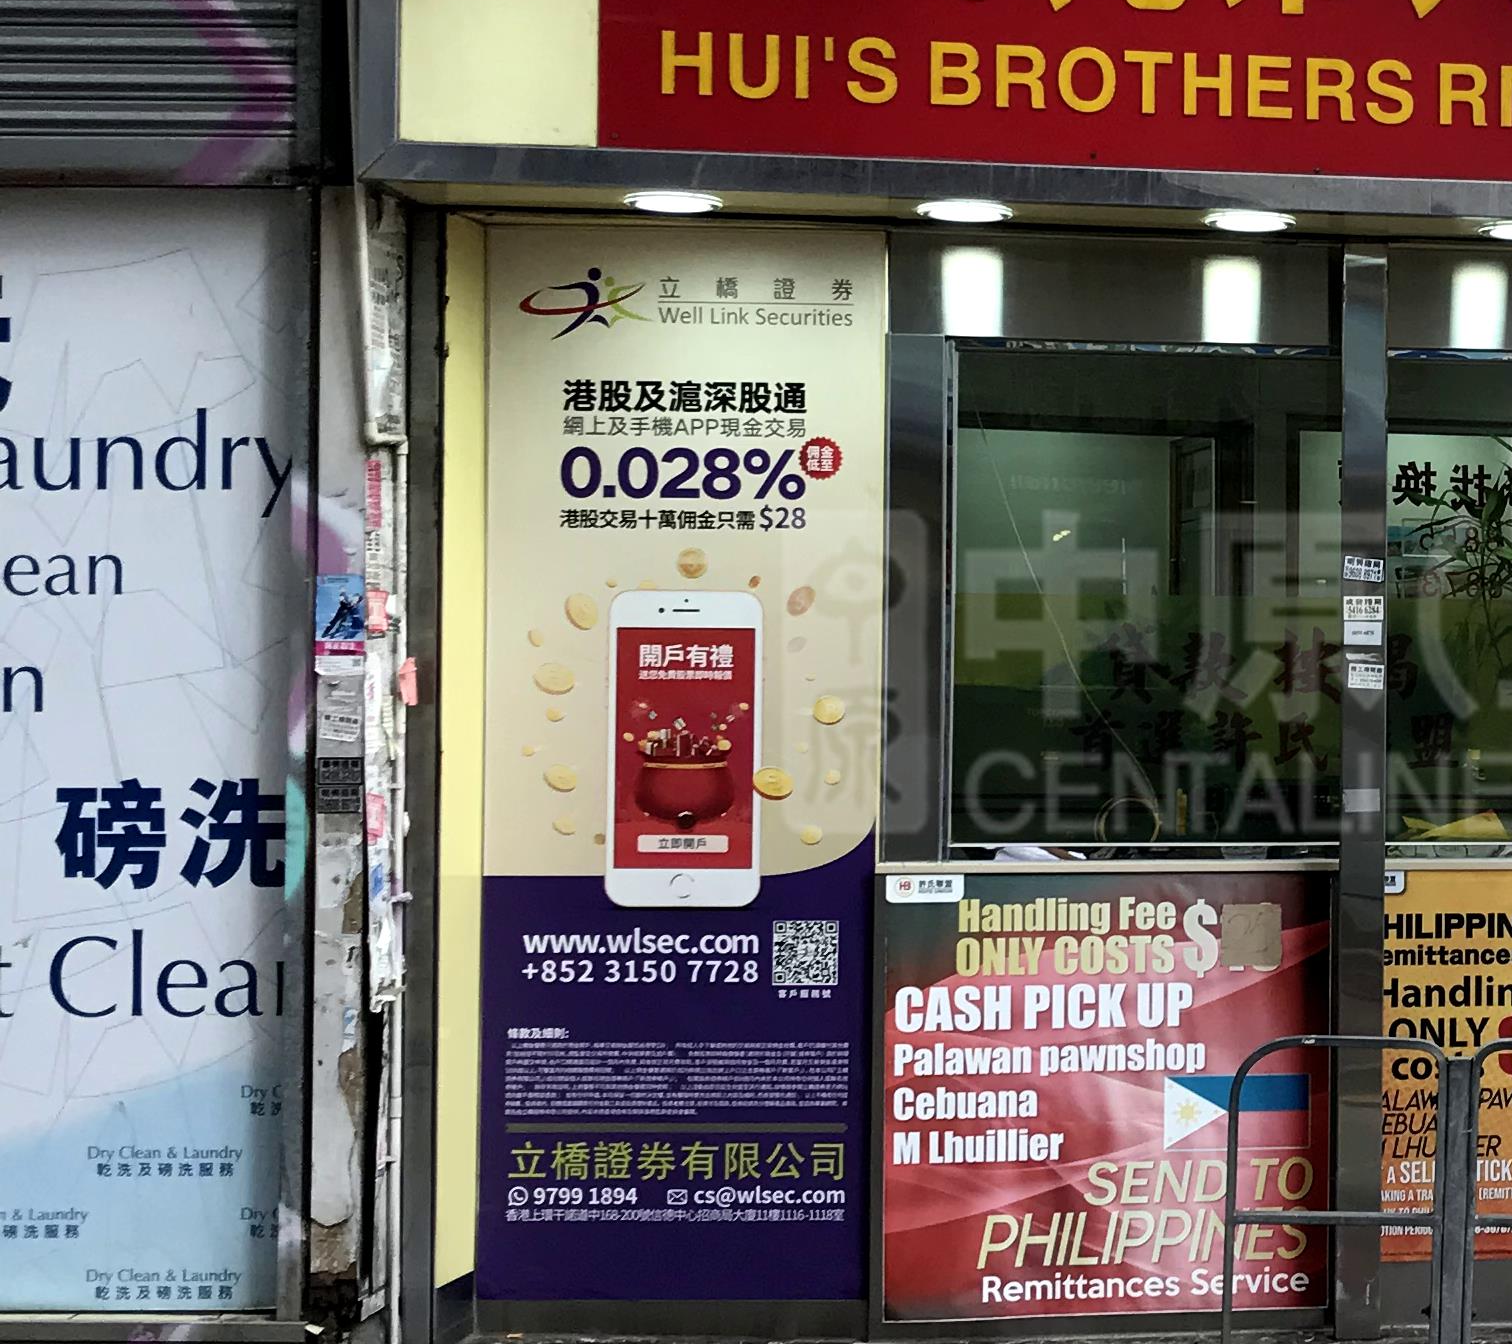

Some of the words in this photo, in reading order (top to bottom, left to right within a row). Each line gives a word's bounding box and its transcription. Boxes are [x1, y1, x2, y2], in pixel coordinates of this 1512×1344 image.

[660, 30, 899, 105] HUI'S
[929, 40, 1414, 126] BROTHERS
[658, 275, 854, 302] 立橋證券
[658, 306, 704, 325] Well
[710, 306, 750, 326] Link
[755, 307, 854, 328] Securities
[562, 379, 808, 414] 港股及滬深股通
[562, 416, 806, 438] 網上及手機APP現金交易
[0, 407, 293, 519] aundry
[560, 446, 807, 501] 0.028%
[559, 509, 756, 530] 港股交易十萬佣金只需
[758, 504, 807, 532] $28
[2, 553, 124, 597] ean
[638, 643, 735, 669] 開戶有禮
[55, 777, 287, 890] 磅洗
[957, 897, 1111, 935] Handling
[1119, 896, 1177, 931] Fee
[522, 927, 760, 955] www.wlsec.com
[956, 937, 1046, 978] ONLY
[1053, 935, 1176, 977] COSTS
[1183, 898, 1219, 979] $
[521, 959, 595, 984] +852
[603, 959, 677, 984] 3150
[686, 959, 760, 984] 7728
[894, 984, 1013, 1033] CASH
[1023, 982, 1128, 1031] PICK
[1136, 982, 1194, 1028] UP
[1388, 1016, 1490, 1049] ONLY
[893, 1042, 1033, 1077] Palawan
[1039, 1038, 1206, 1077] pawnshop
[893, 1086, 1038, 1121] Cebuana
[1382, 1089, 1439, 1112] ALAW
[87, 1145, 115, 1163] Dry
[118, 1145, 162, 1160] Clean
[166, 1146, 177, 1160] &
[183, 1145, 243, 1163] Laundry
[507, 1141, 846, 1181] 立橋證券有限公司
[892, 1131, 921, 1165] M
[928, 1128, 1065, 1164] Lhuillier
[532, 1187, 584, 1205] 9799
[588, 1187, 639, 1205] 1894
[693, 1186, 846, 1208] cs@wlsec.com
[1083, 1158, 1231, 1206] SEND
[1250, 1156, 1314, 1202] TO
[12, 1208, 23, 1222] &
[28, 1207, 90, 1224] Laundry
[976, 1206, 1308, 1271] PHILIPPINES
[86, 1268, 114, 1285] Dry
[117, 1268, 161, 1283] Clean
[165, 1269, 177, 1283] &
[182, 1268, 242, 1286] Laundry
[981, 1272, 1181, 1304] Remittances
[1190, 1265, 1310, 1297] Service
